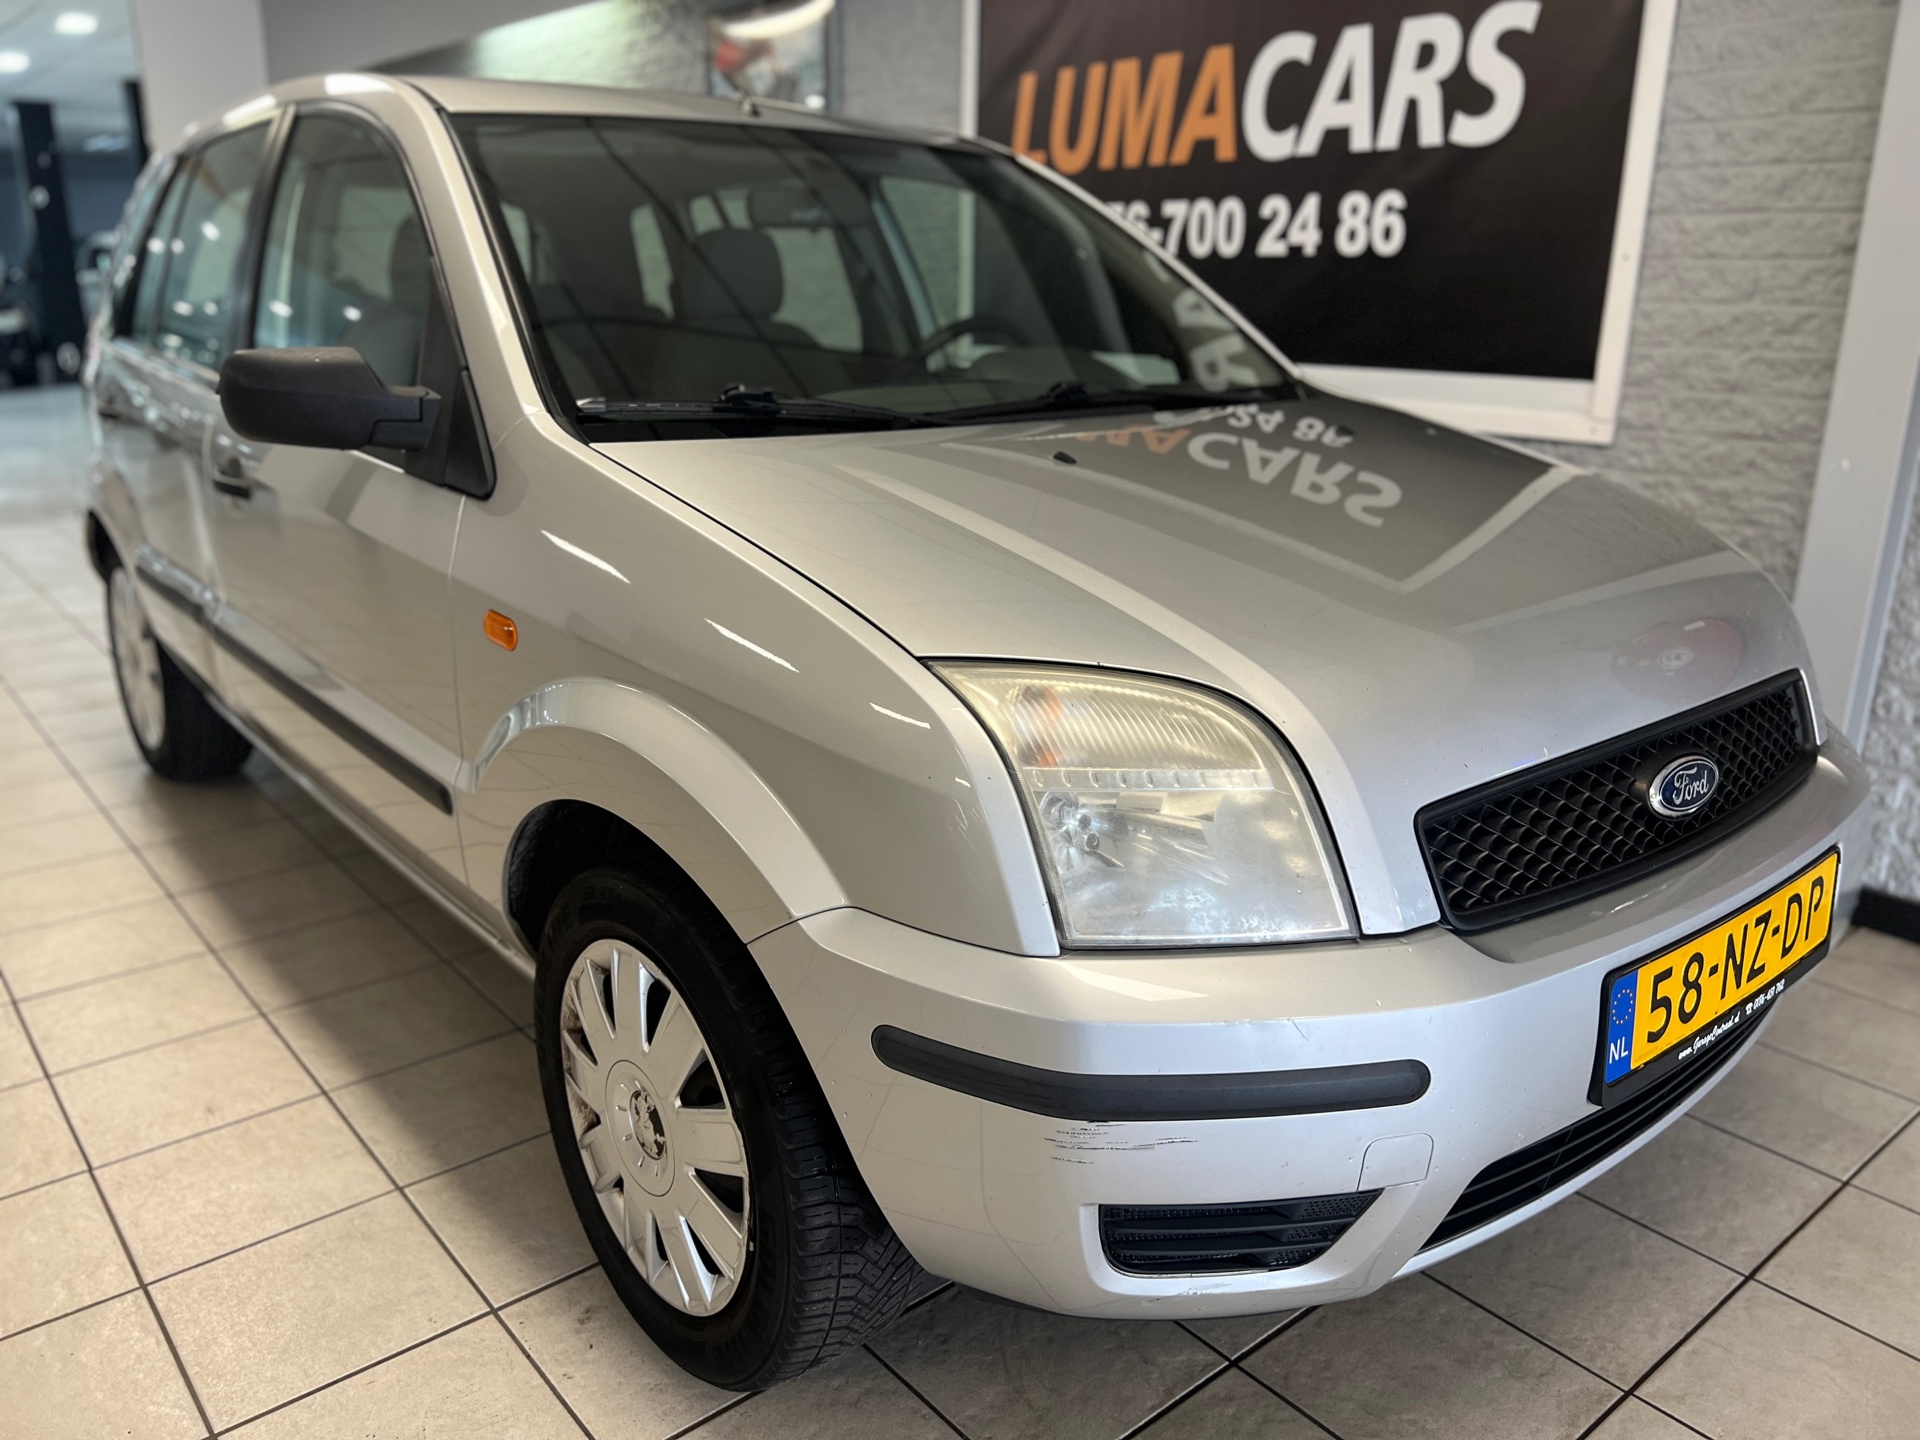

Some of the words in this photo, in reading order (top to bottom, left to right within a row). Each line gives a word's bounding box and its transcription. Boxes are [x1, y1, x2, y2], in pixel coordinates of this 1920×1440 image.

[1010, 0, 1542, 175] LUMACARS
[1255, 193, 1323, 259] 24
[1334, 188, 1408, 259] 86
[1673, 766, 1709, 805] Ford
[1647, 875, 1825, 1043] 58-NZ-DP
[1609, 1036, 1629, 1064] NL
